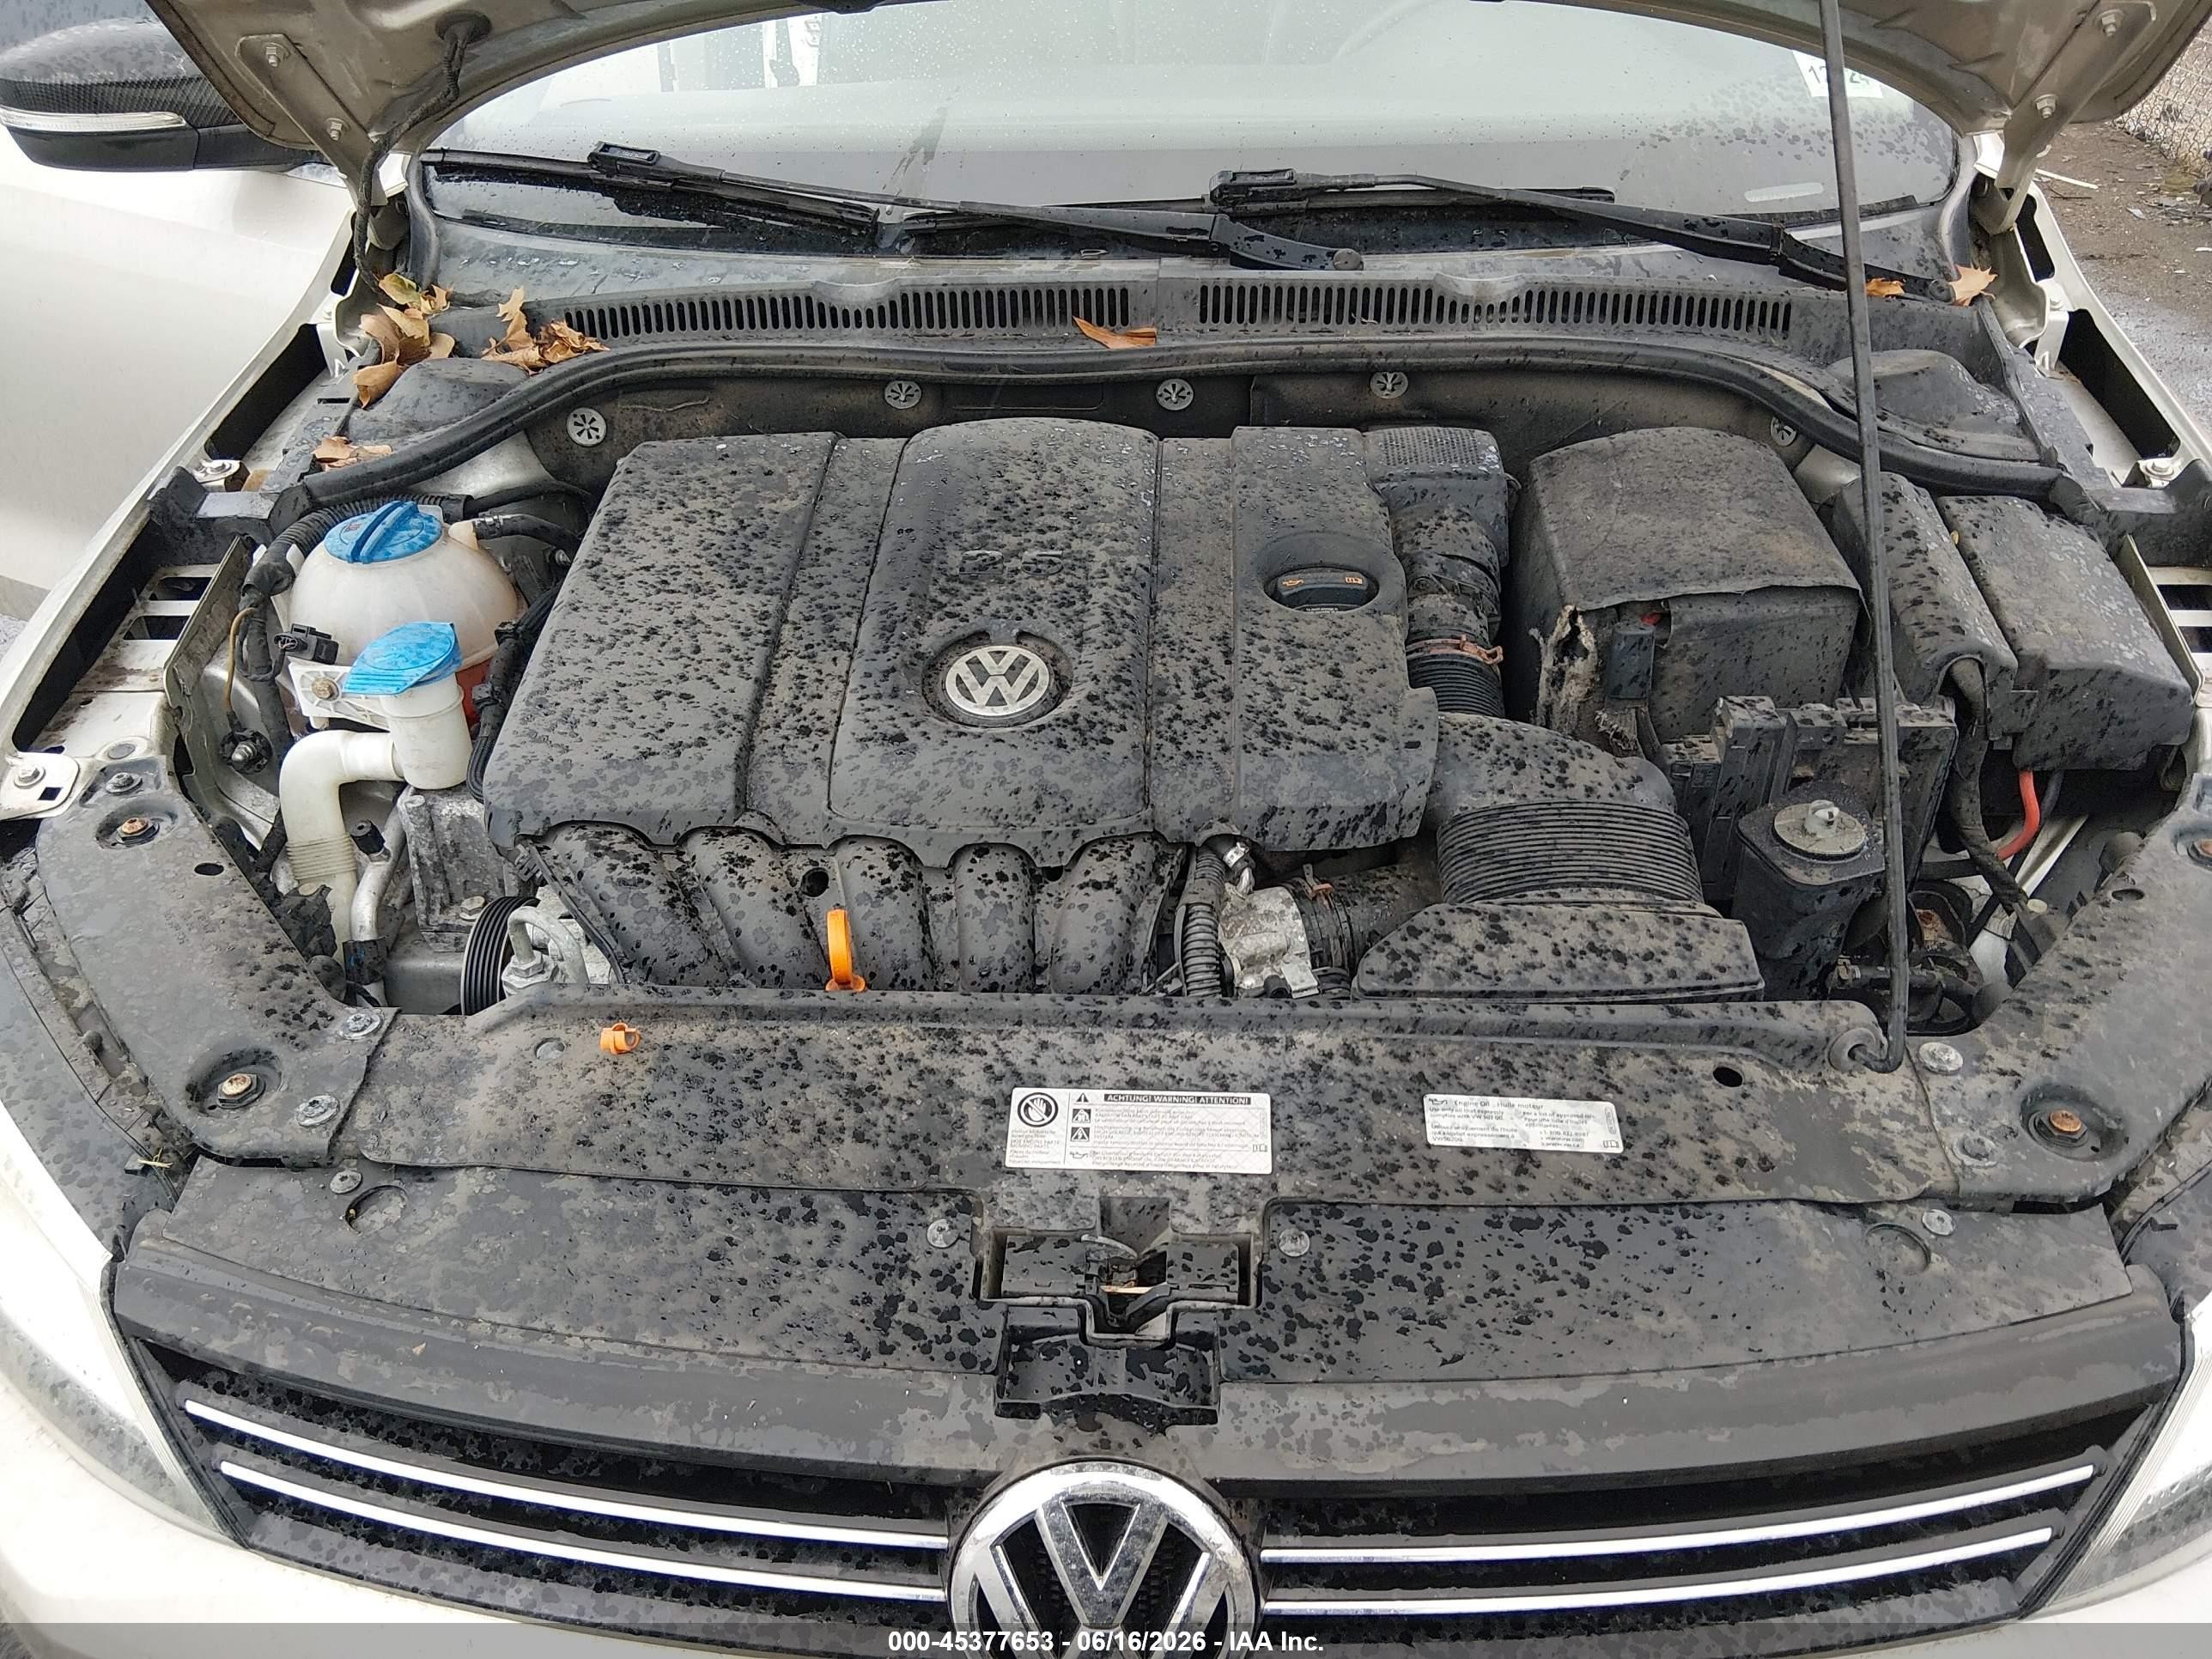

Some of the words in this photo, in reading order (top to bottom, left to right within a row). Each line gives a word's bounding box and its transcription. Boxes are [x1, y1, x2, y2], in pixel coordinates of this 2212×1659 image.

[945, 646, 1049, 716] VW
[1107, 1094, 1152, 1103] ACHTUNG!
[1153, 1095, 1198, 1104] WARNING!
[1199, 1097, 1249, 1105] ATTENTION!
